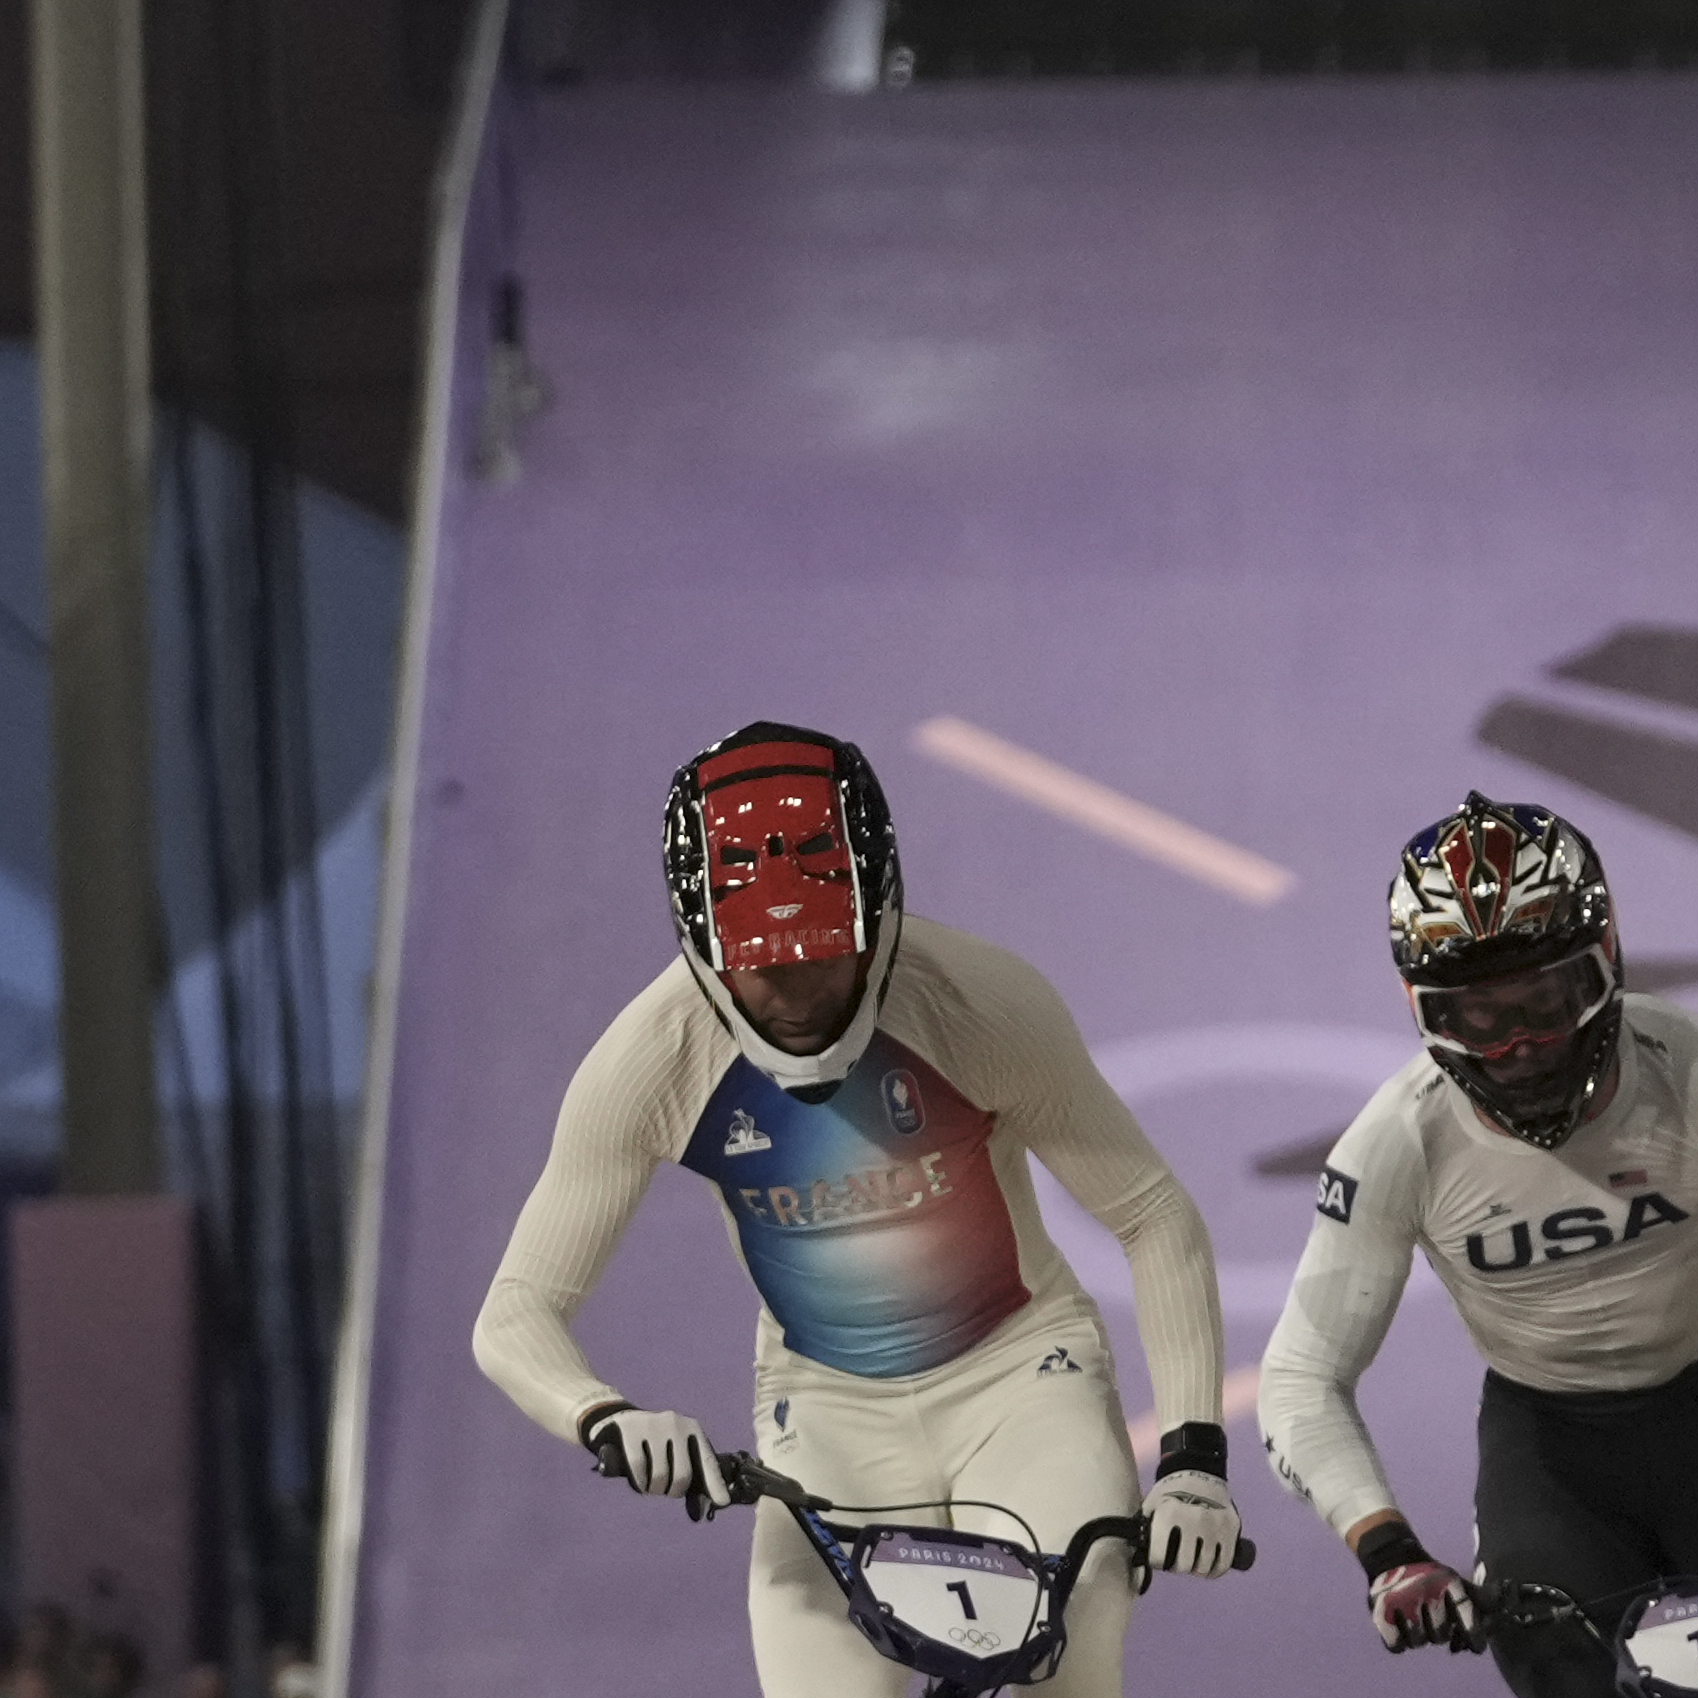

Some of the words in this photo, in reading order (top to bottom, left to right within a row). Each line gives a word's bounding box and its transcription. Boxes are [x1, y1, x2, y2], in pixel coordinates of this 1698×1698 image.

[739, 1151, 953, 1227] FRANCE
[1466, 1191, 1690, 1273] USA
[899, 1547, 952, 1563] PARIS
[957, 1550, 1005, 1571] 2024
[945, 1580, 977, 1620] 1
